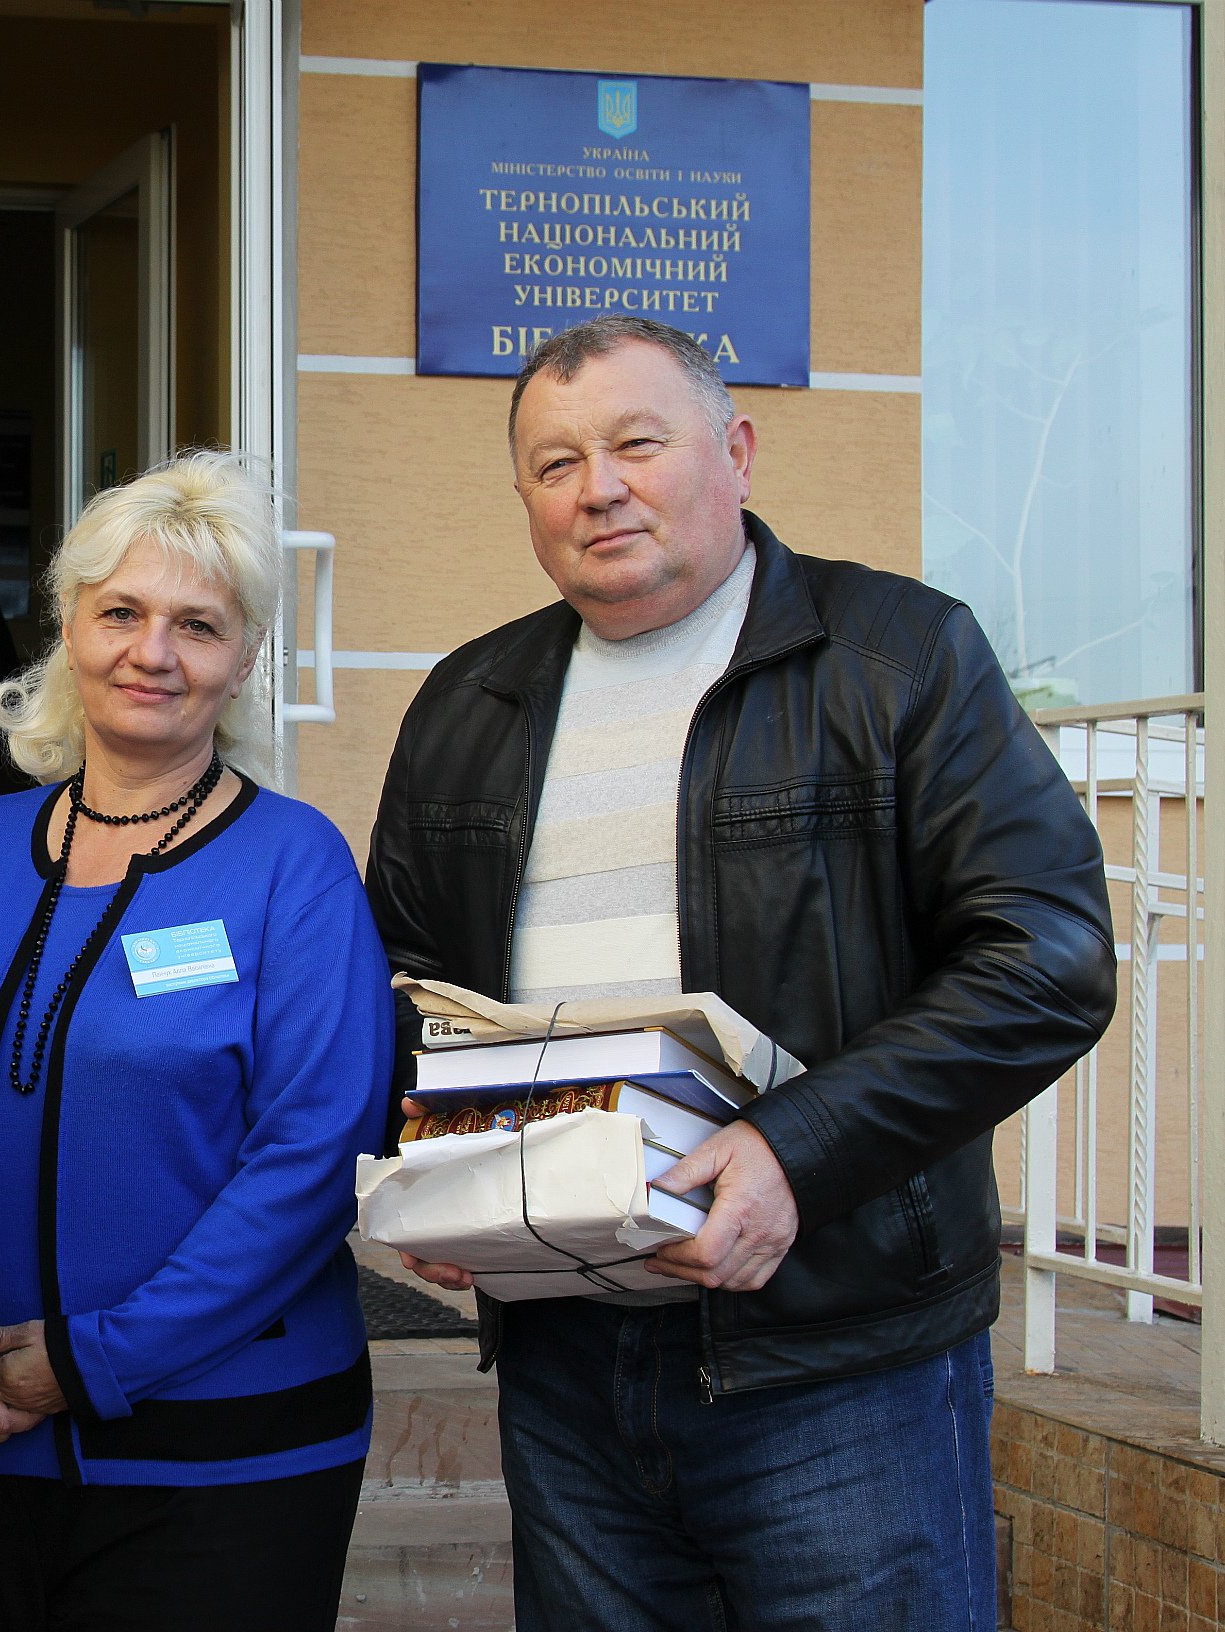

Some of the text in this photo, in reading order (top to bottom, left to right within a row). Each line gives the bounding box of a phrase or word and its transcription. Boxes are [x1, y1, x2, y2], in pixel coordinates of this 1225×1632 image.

[582, 147, 650, 162] УКРАЇНА
[491, 162, 742, 184] МІНІСТЕРСТВО ОСВІТИ І НАУКИ
[479, 189, 751, 221] ТЕРНОПІЛЬСЬКИЙ
[499, 221, 742, 252] НАЦІОНАЛЬНИЙ
[503, 253, 729, 283] ЕКОНОМІЧНИЙ
[514, 284, 719, 313] УНІВЕРСИТЕТ
